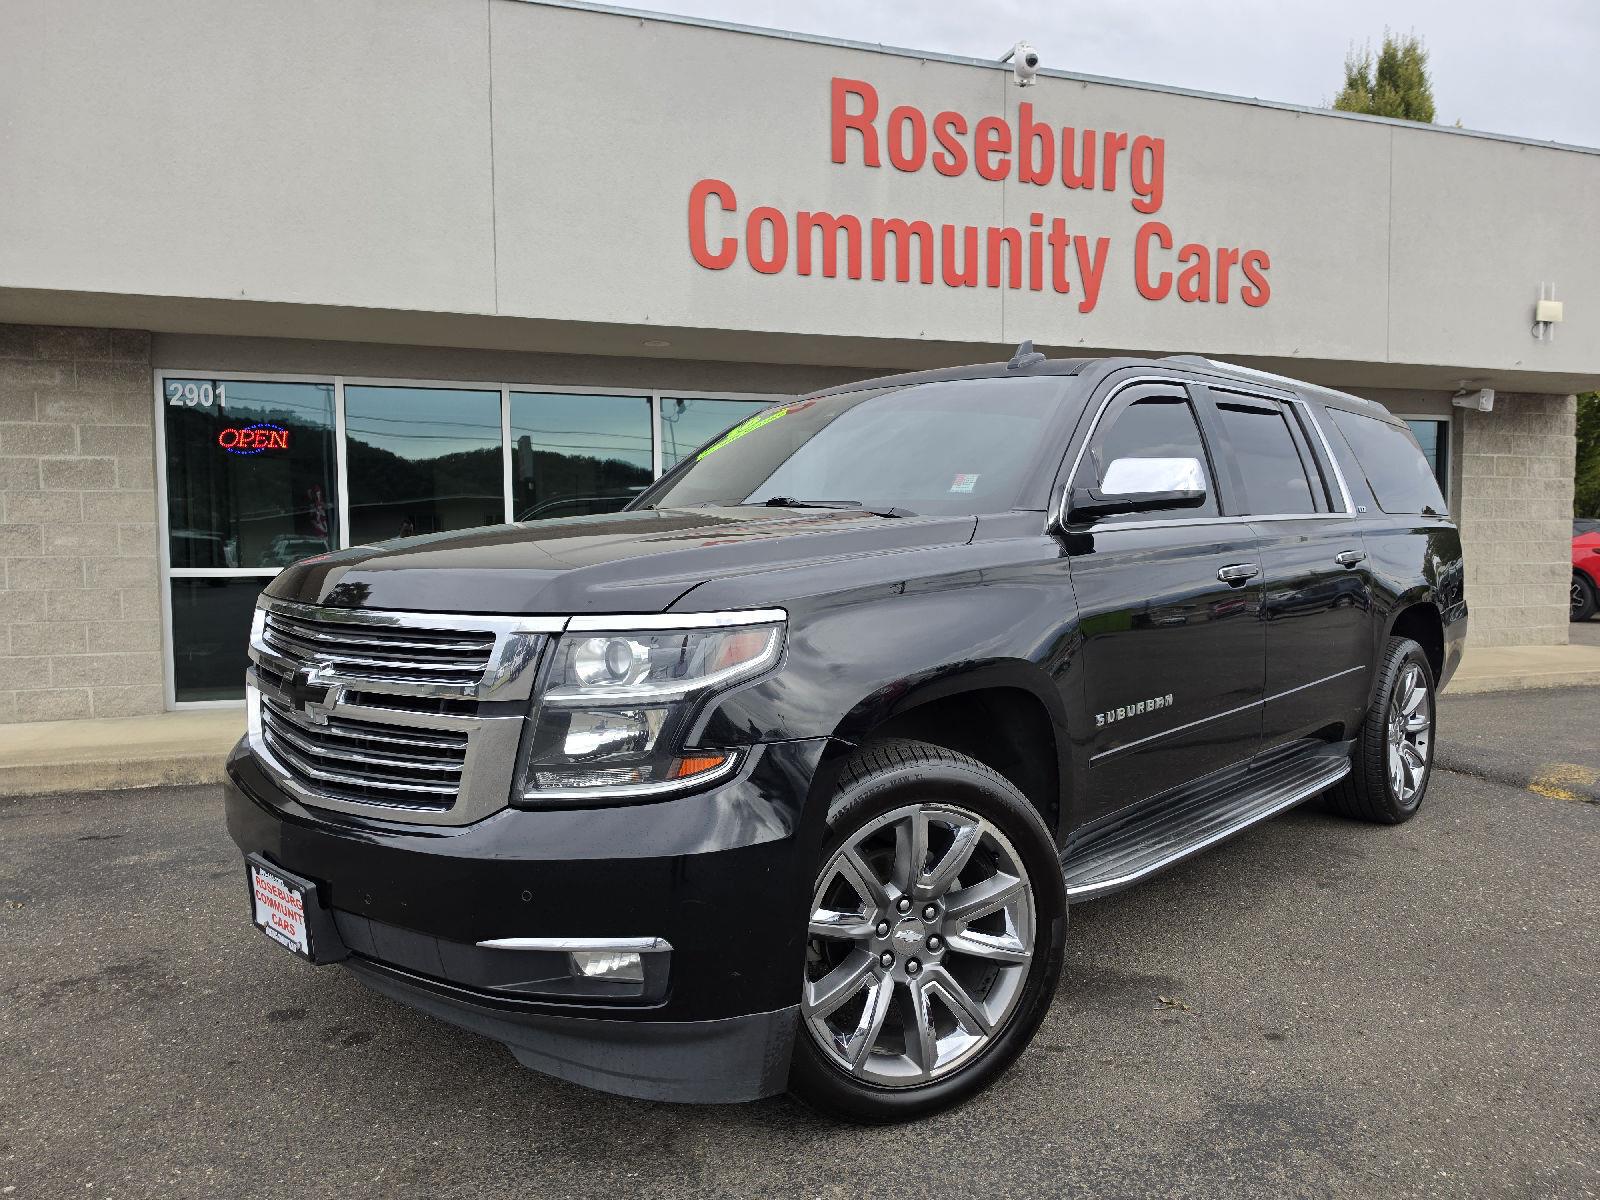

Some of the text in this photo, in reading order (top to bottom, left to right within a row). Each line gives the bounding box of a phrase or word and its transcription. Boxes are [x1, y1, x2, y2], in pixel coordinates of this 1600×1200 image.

[830, 76, 1165, 214] Roseburg
[688, 178, 1271, 313] Community Cars
[169, 383, 226, 407] 2901
[217, 428, 289, 449] OPEN
[1095, 693, 1174, 727] SUBURBAN
[255, 875, 304, 911] ROSEBURG
[271, 912, 296, 937] CARS
